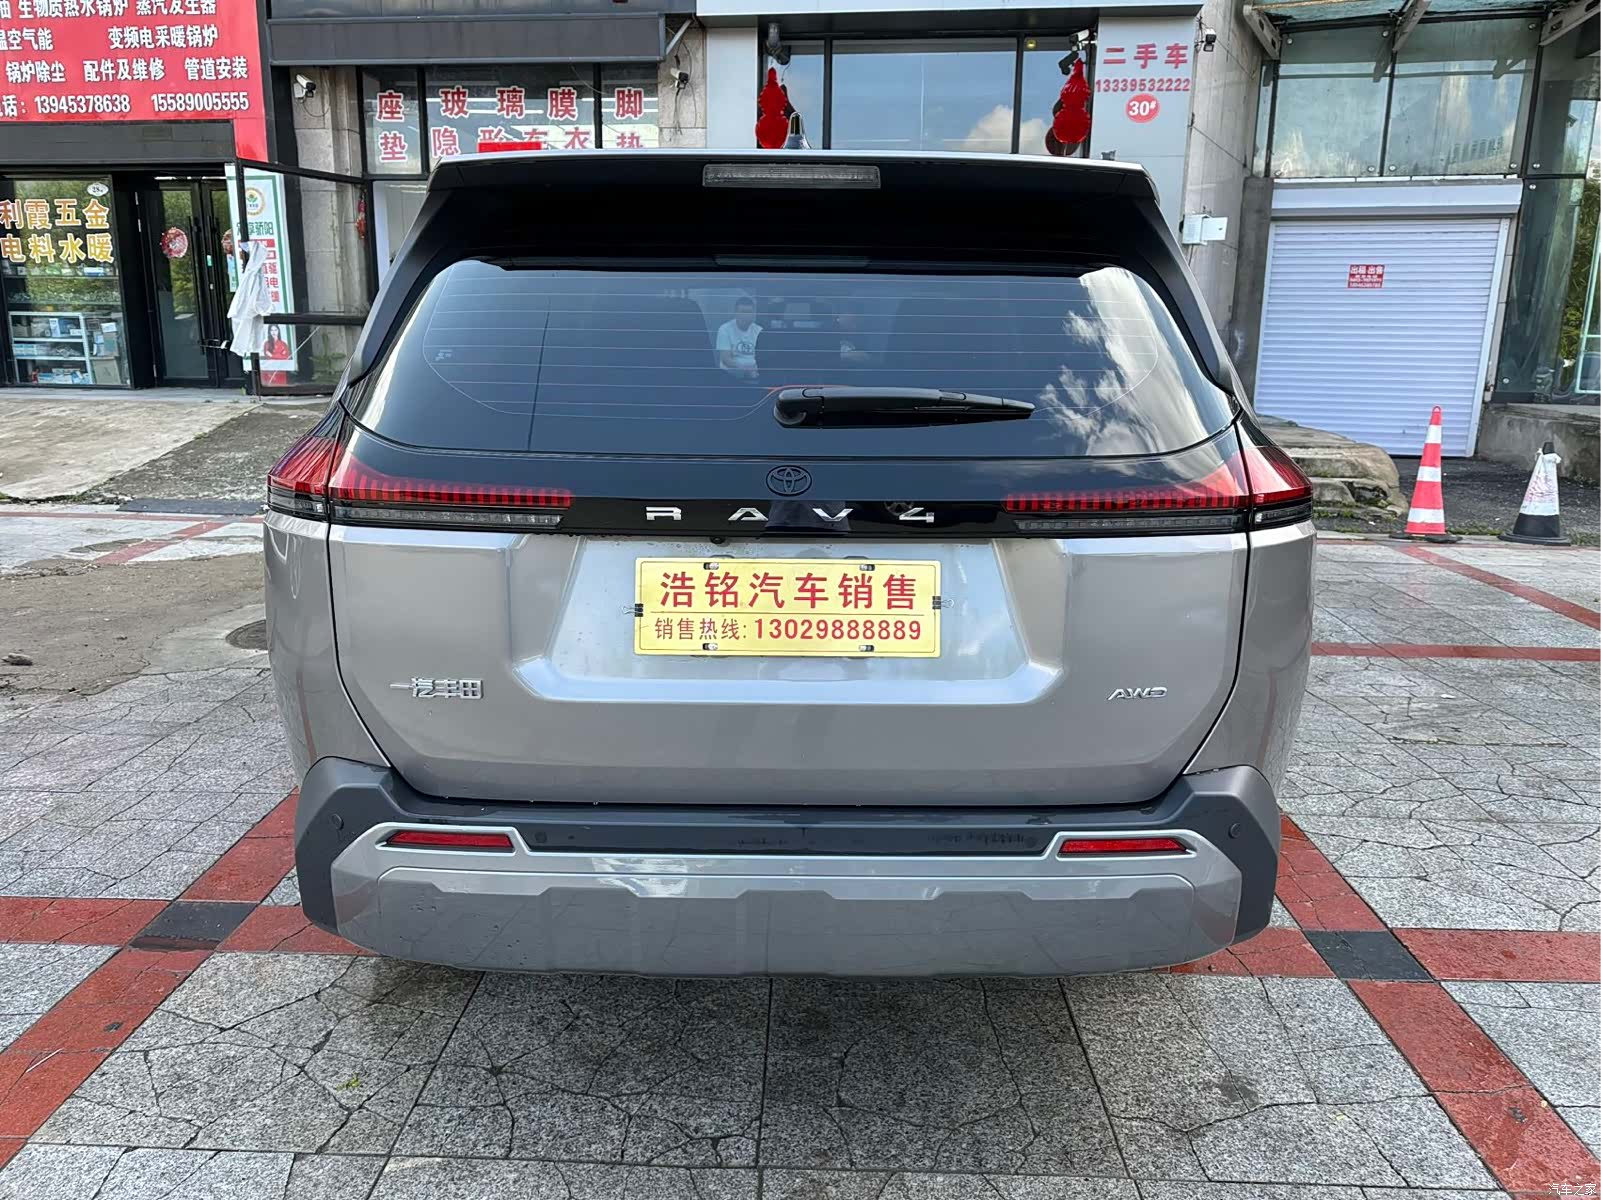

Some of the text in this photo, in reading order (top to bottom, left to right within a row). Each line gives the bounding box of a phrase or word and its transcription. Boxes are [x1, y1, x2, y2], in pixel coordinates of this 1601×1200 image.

[18, 0, 129, 17] 生物质热水锅炉
[107, 24, 219, 50] 变频电采暖锅炉
[1103, 43, 1189, 69] 二手车
[5, 56, 249, 83] 锅炉除尘 配件及维修 管道安装
[1096, 78, 1190, 92] 13339532222
[34, 94, 131, 114] 13945378638
[151, 92, 249, 112] 15589005555
[1128, 100, 1157, 116] 30#
[0, 198, 110, 230] 利霞五金
[0, 233, 114, 263] 电料水暖
[645, 505, 935, 524] RAV4
[660, 570, 917, 611] 浩铭汽车销售
[389, 677, 484, 700] 一汽丰田
[1106, 686, 1168, 701] AWD
